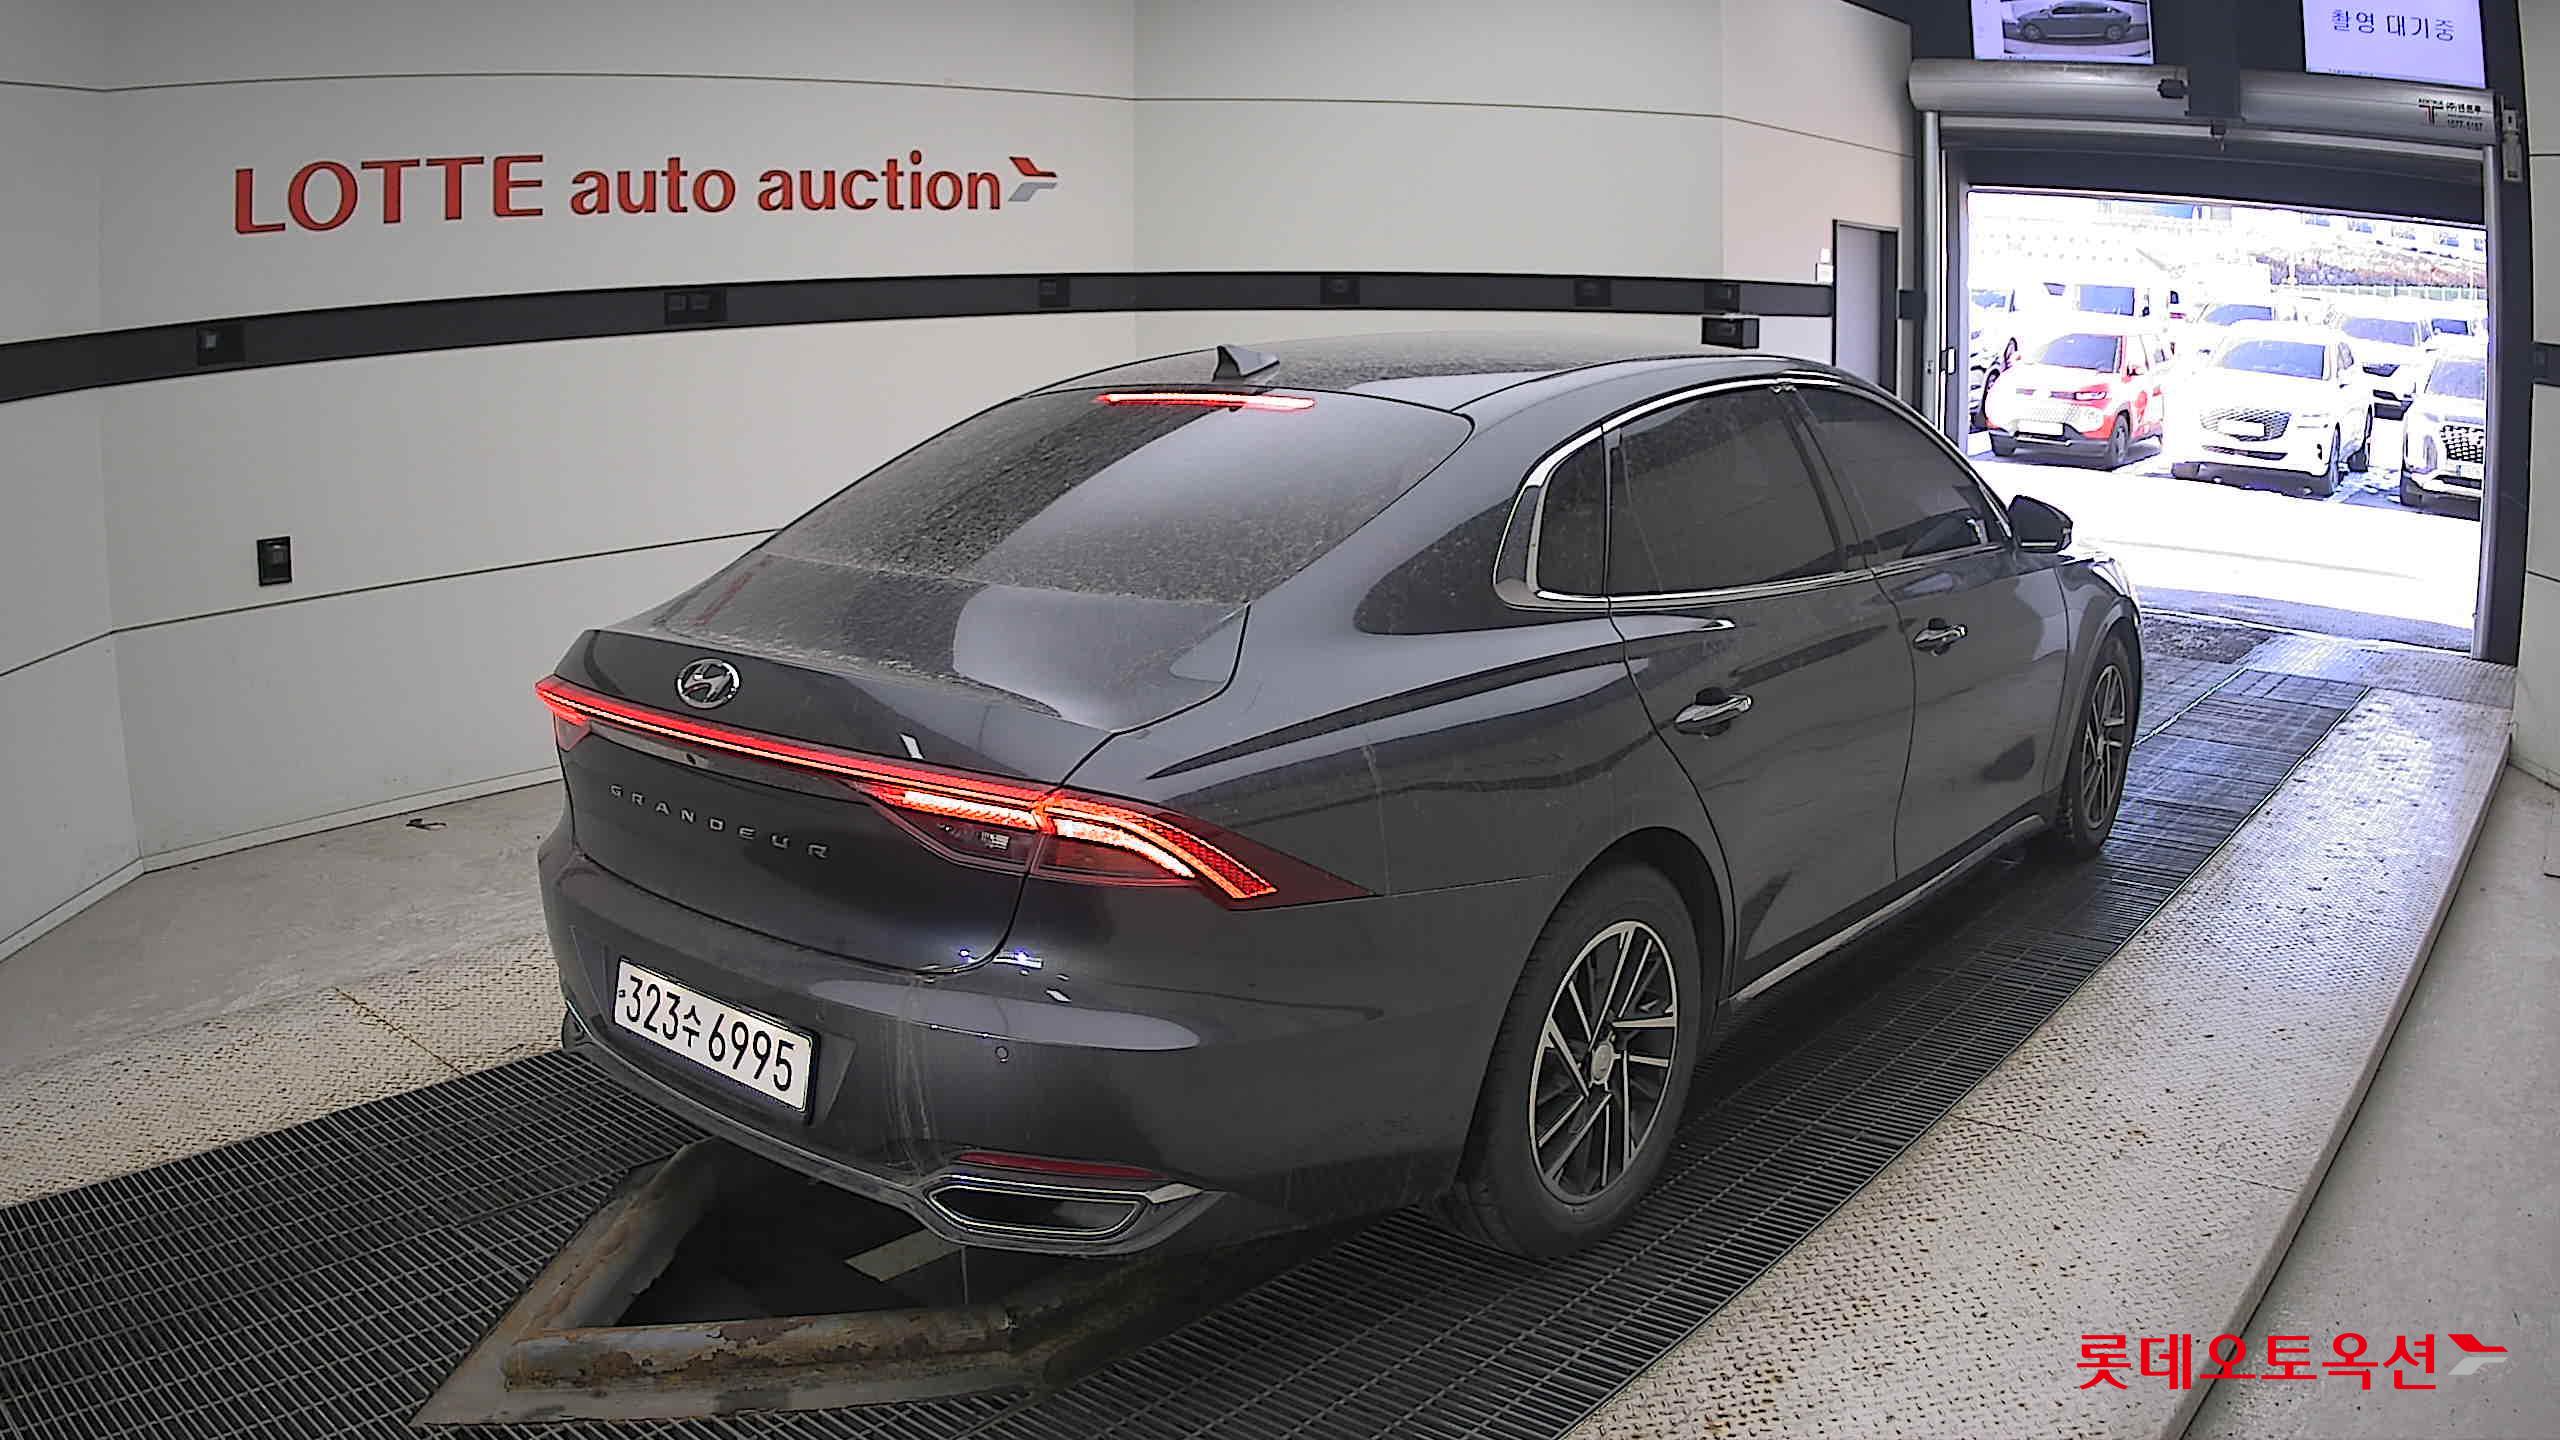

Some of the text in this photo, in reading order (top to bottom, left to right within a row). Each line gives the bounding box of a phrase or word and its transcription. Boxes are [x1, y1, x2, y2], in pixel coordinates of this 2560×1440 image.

[2332, 10, 2455, 42] 촬영 대기중
[234, 150, 1001, 234] LOTTE auto auction
[609, 783, 829, 859] GRANDEUR
